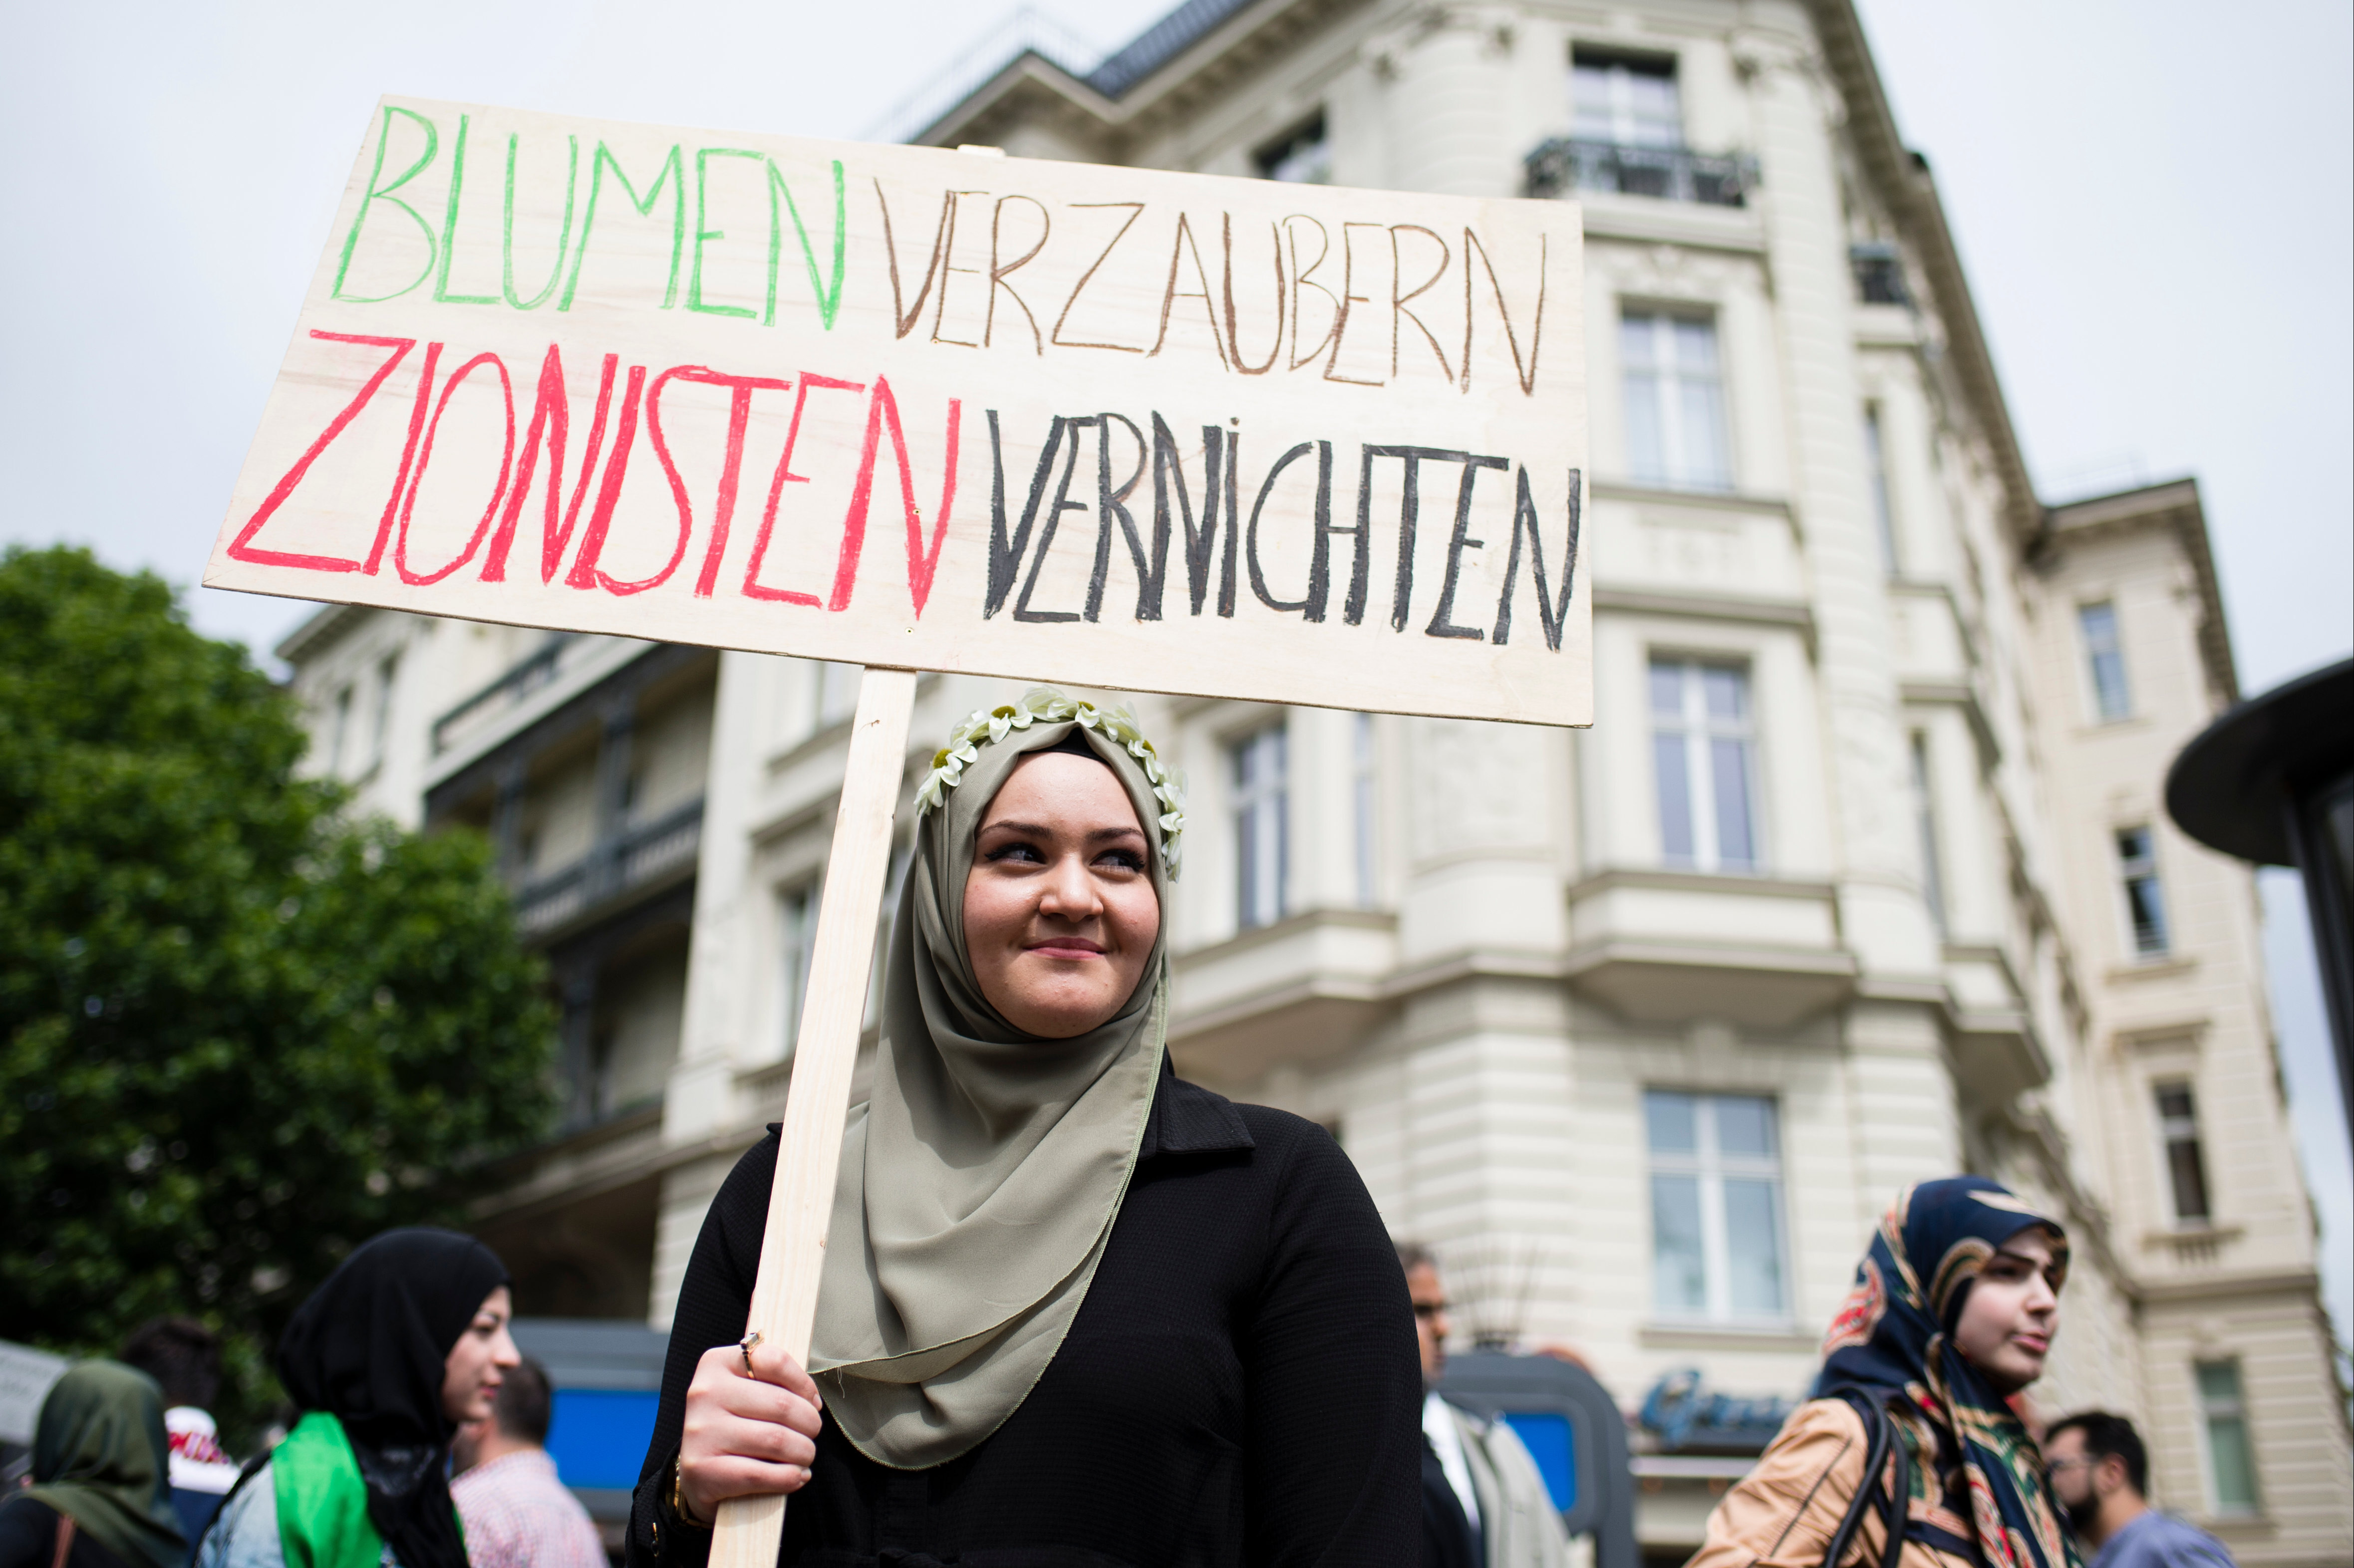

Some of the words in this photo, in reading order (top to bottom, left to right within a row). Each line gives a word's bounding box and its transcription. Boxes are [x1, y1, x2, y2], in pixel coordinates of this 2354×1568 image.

[331, 106, 845, 330] BLUMEN
[874, 177, 1546, 396] VERZAUBERN
[227, 329, 961, 621] ZIONISTEN
